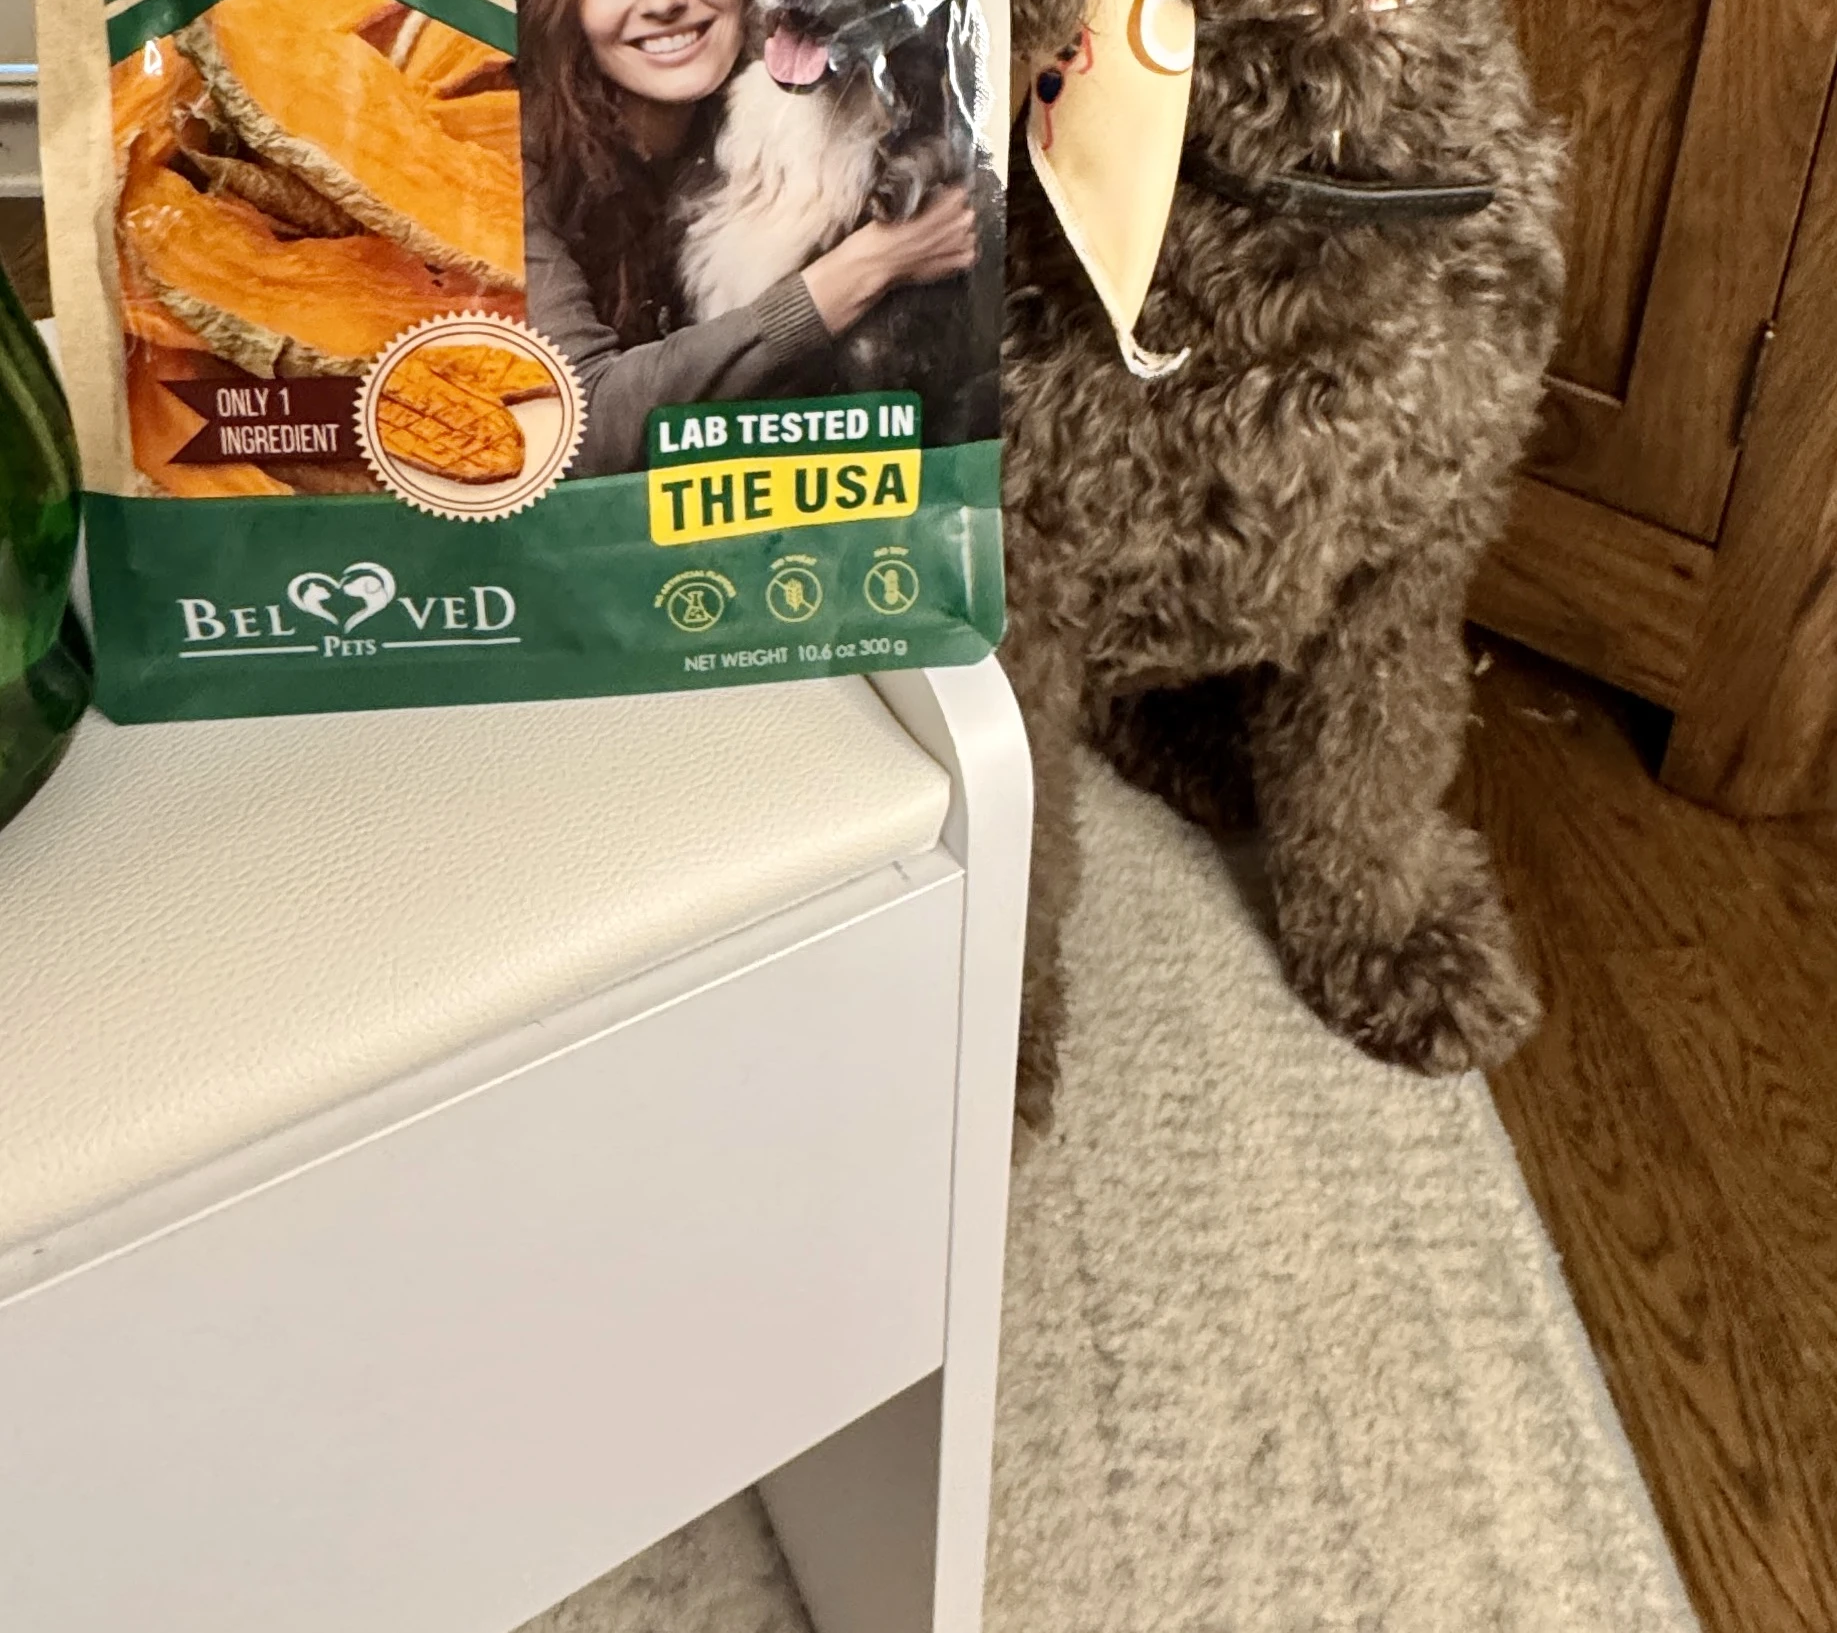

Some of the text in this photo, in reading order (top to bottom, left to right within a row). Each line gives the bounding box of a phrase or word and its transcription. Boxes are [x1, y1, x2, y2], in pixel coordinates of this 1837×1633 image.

[216, 387, 290, 418] ONLY 1
[220, 423, 340, 455] INGREDIENT
[659, 404, 915, 453] LAB TESTED IN
[660, 463, 907, 533] THE USA
[684, 637, 908, 672] NET WEIGHT 10.6 oz 300 g
